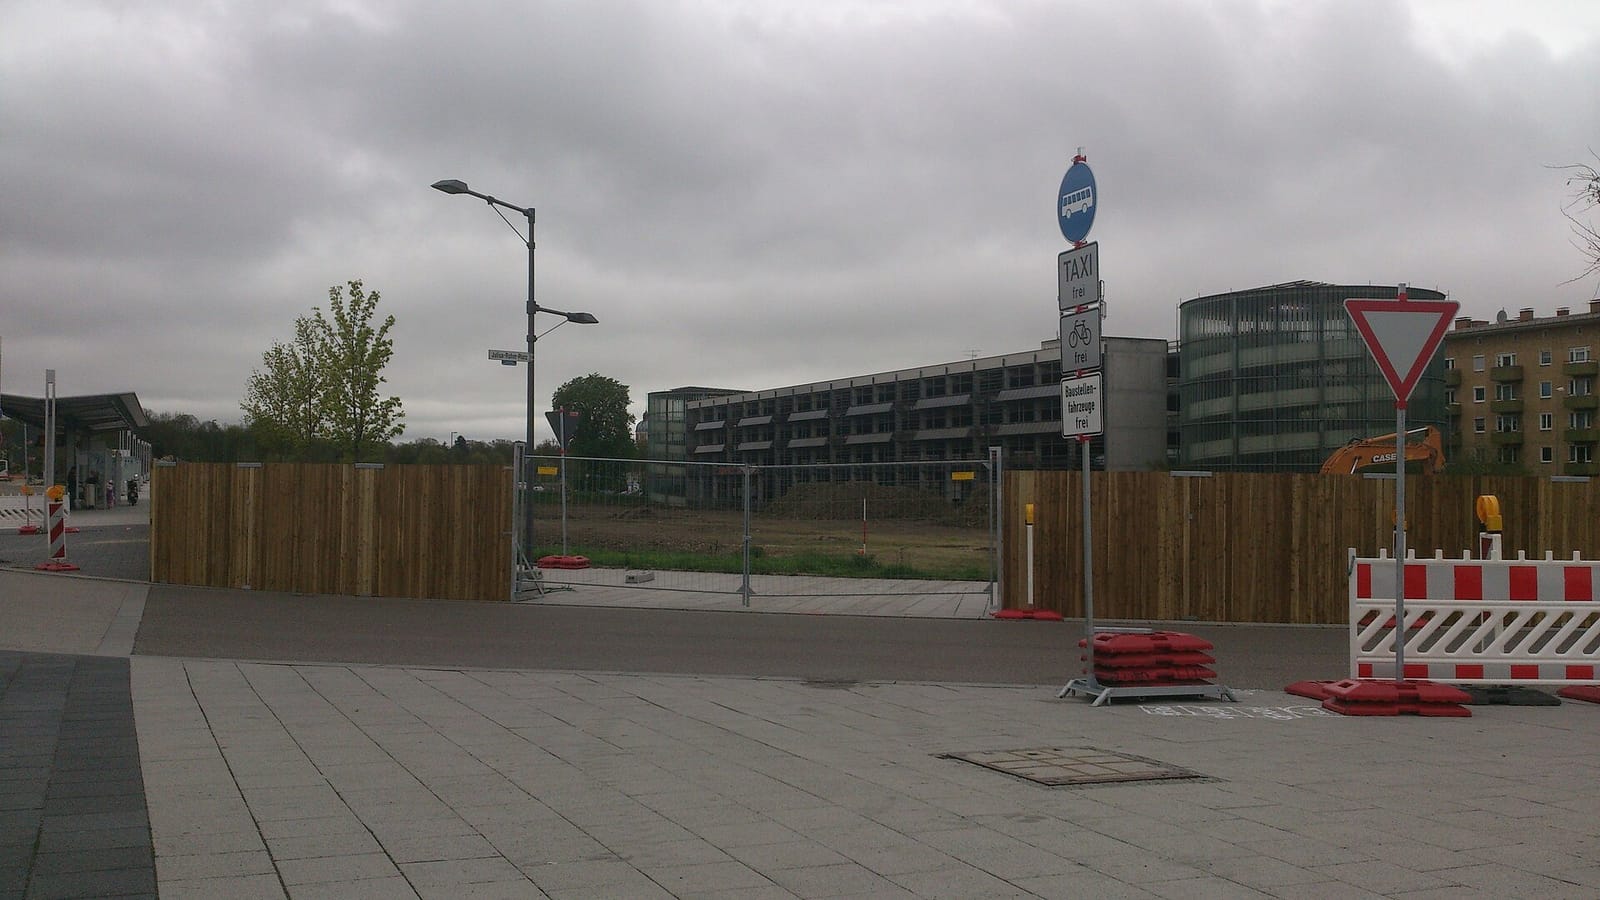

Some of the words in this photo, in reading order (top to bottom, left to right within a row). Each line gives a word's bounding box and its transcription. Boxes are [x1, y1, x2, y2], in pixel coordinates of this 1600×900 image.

[1063, 254, 1093, 283] TAXI
[1072, 286, 1086, 300] frei
[1074, 351, 1088, 364] frei
[1065, 383, 1097, 398] Baustellen-
[1068, 401, 1095, 414] fahrzeuge
[1076, 416, 1089, 429] frei
[1373, 453, 1397, 463] CASE
